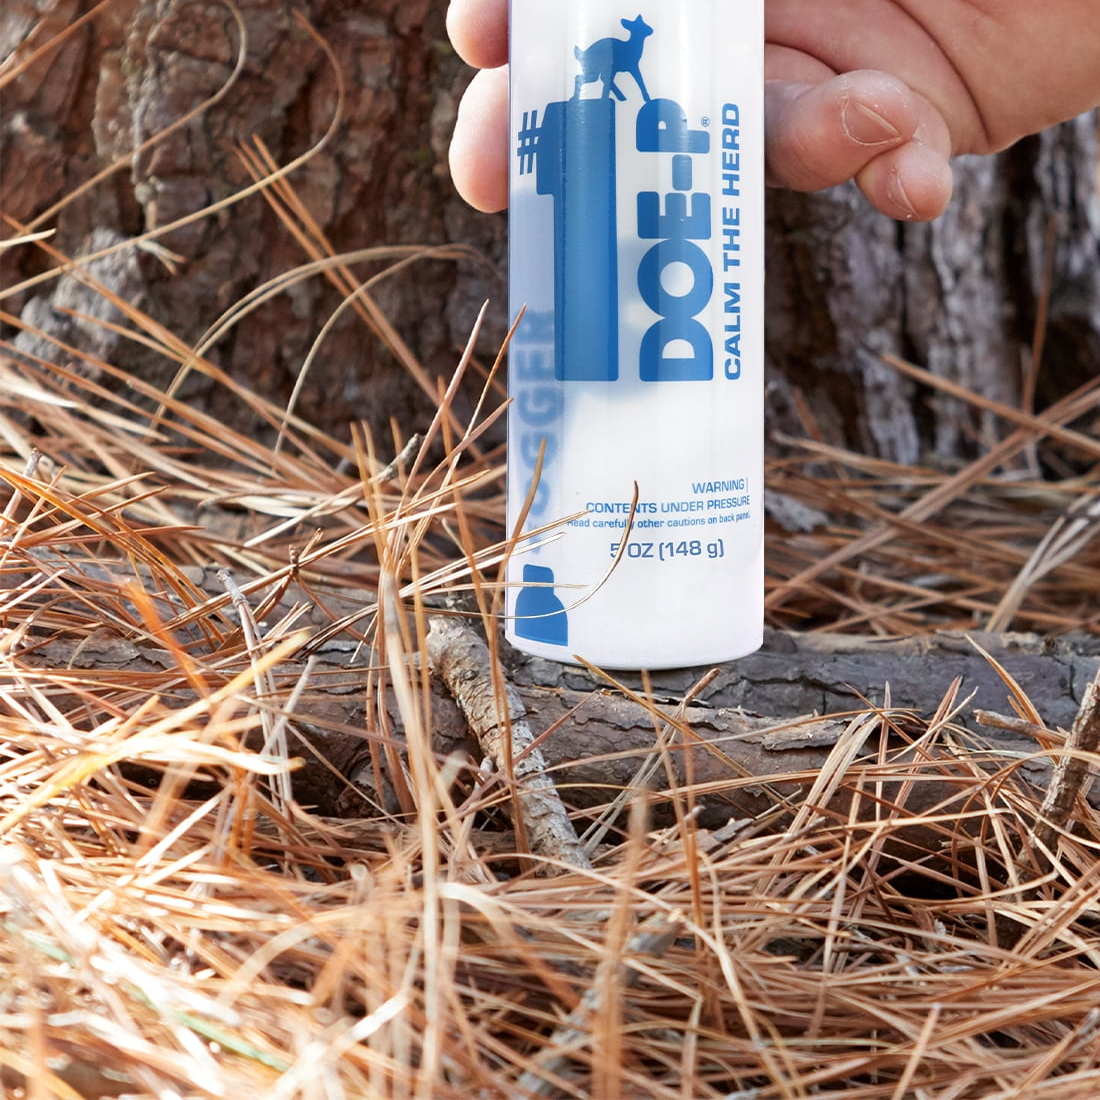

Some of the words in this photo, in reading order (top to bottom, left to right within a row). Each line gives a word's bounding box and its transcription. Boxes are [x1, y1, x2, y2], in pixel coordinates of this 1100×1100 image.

[720, 102, 740, 197] HERD
[721, 206, 741, 273] THE
[724, 281, 741, 381] CALM
[637, 518, 663, 529] other
[667, 516, 706, 528] cautions
[707, 515, 718, 525] on
[719, 513, 735, 524] back
[661, 500, 704, 513] UNDER
[707, 495, 750, 510] PRESSURE
[610, 542, 622, 558] 5
[627, 542, 654, 558] OZ
[658, 540, 702, 561] (148
[707, 538, 725, 559] g)
